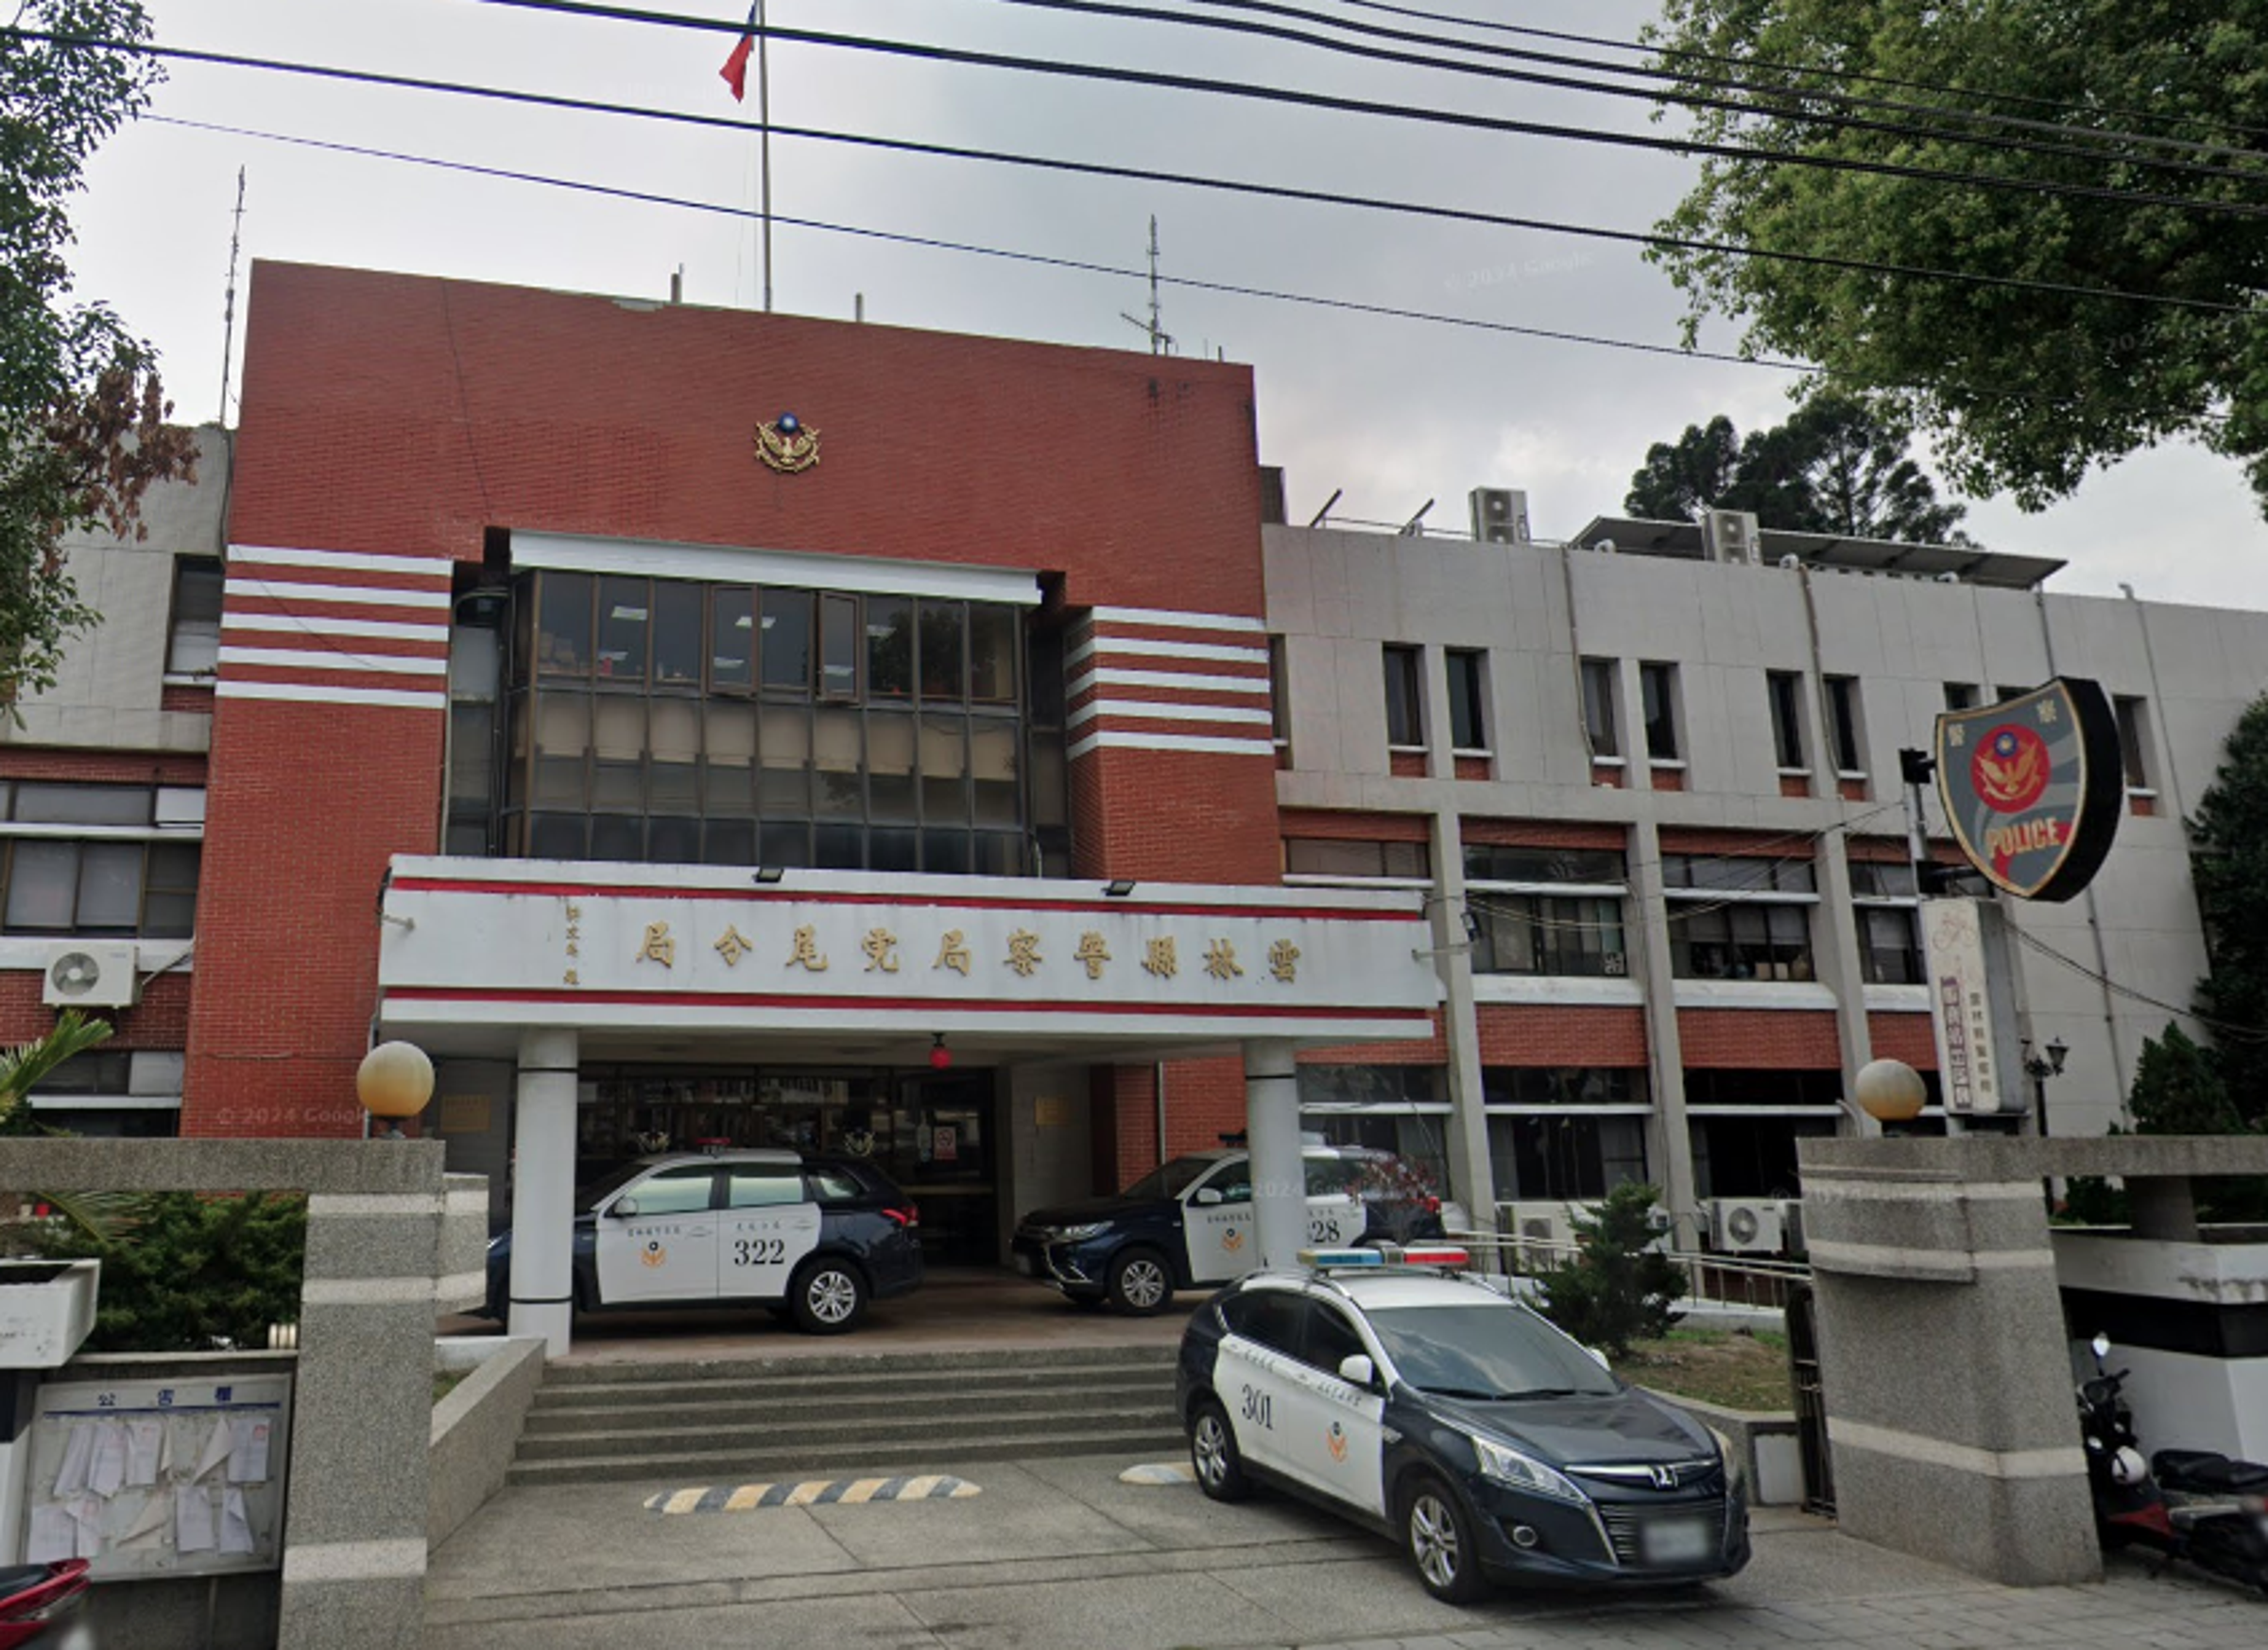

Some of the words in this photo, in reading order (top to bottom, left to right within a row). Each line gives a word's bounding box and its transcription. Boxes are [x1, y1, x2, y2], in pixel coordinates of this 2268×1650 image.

[1986, 816, 2061, 859] POLICE
[1307, 1219, 1341, 1244] 28
[734, 1238, 785, 1266] 322
[1242, 1384, 1273, 1431] 301
